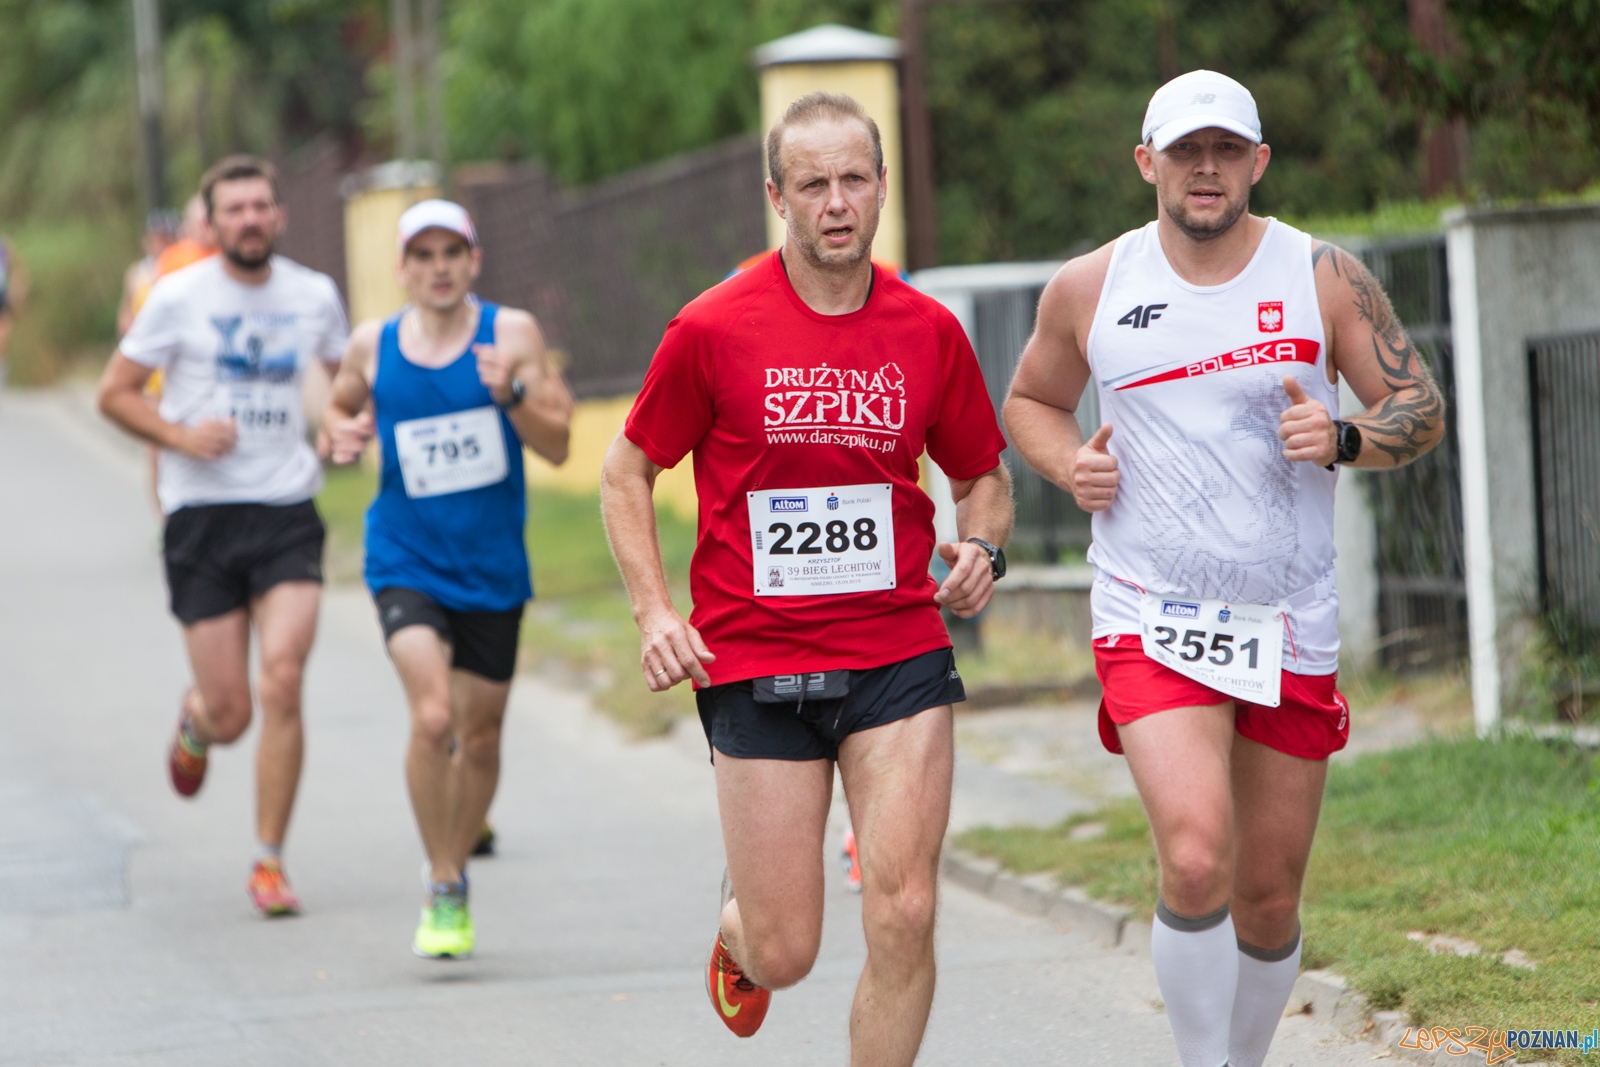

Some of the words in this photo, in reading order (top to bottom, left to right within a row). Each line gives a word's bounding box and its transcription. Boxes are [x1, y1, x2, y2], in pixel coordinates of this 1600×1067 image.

[1117, 303, 1168, 328] 4F
[1186, 342, 1296, 377] POLSKA
[764, 362, 886, 392] DRUŻYNA
[764, 390, 906, 430] SZPIKU
[766, 430, 896, 453] www.darszpiku.pl
[768, 518, 878, 555] 2288
[788, 566, 800, 576] 39
[802, 565, 828, 576] BIEG
[832, 560, 882, 574] LECHITÓW
[1154, 626, 1260, 669] 2551
